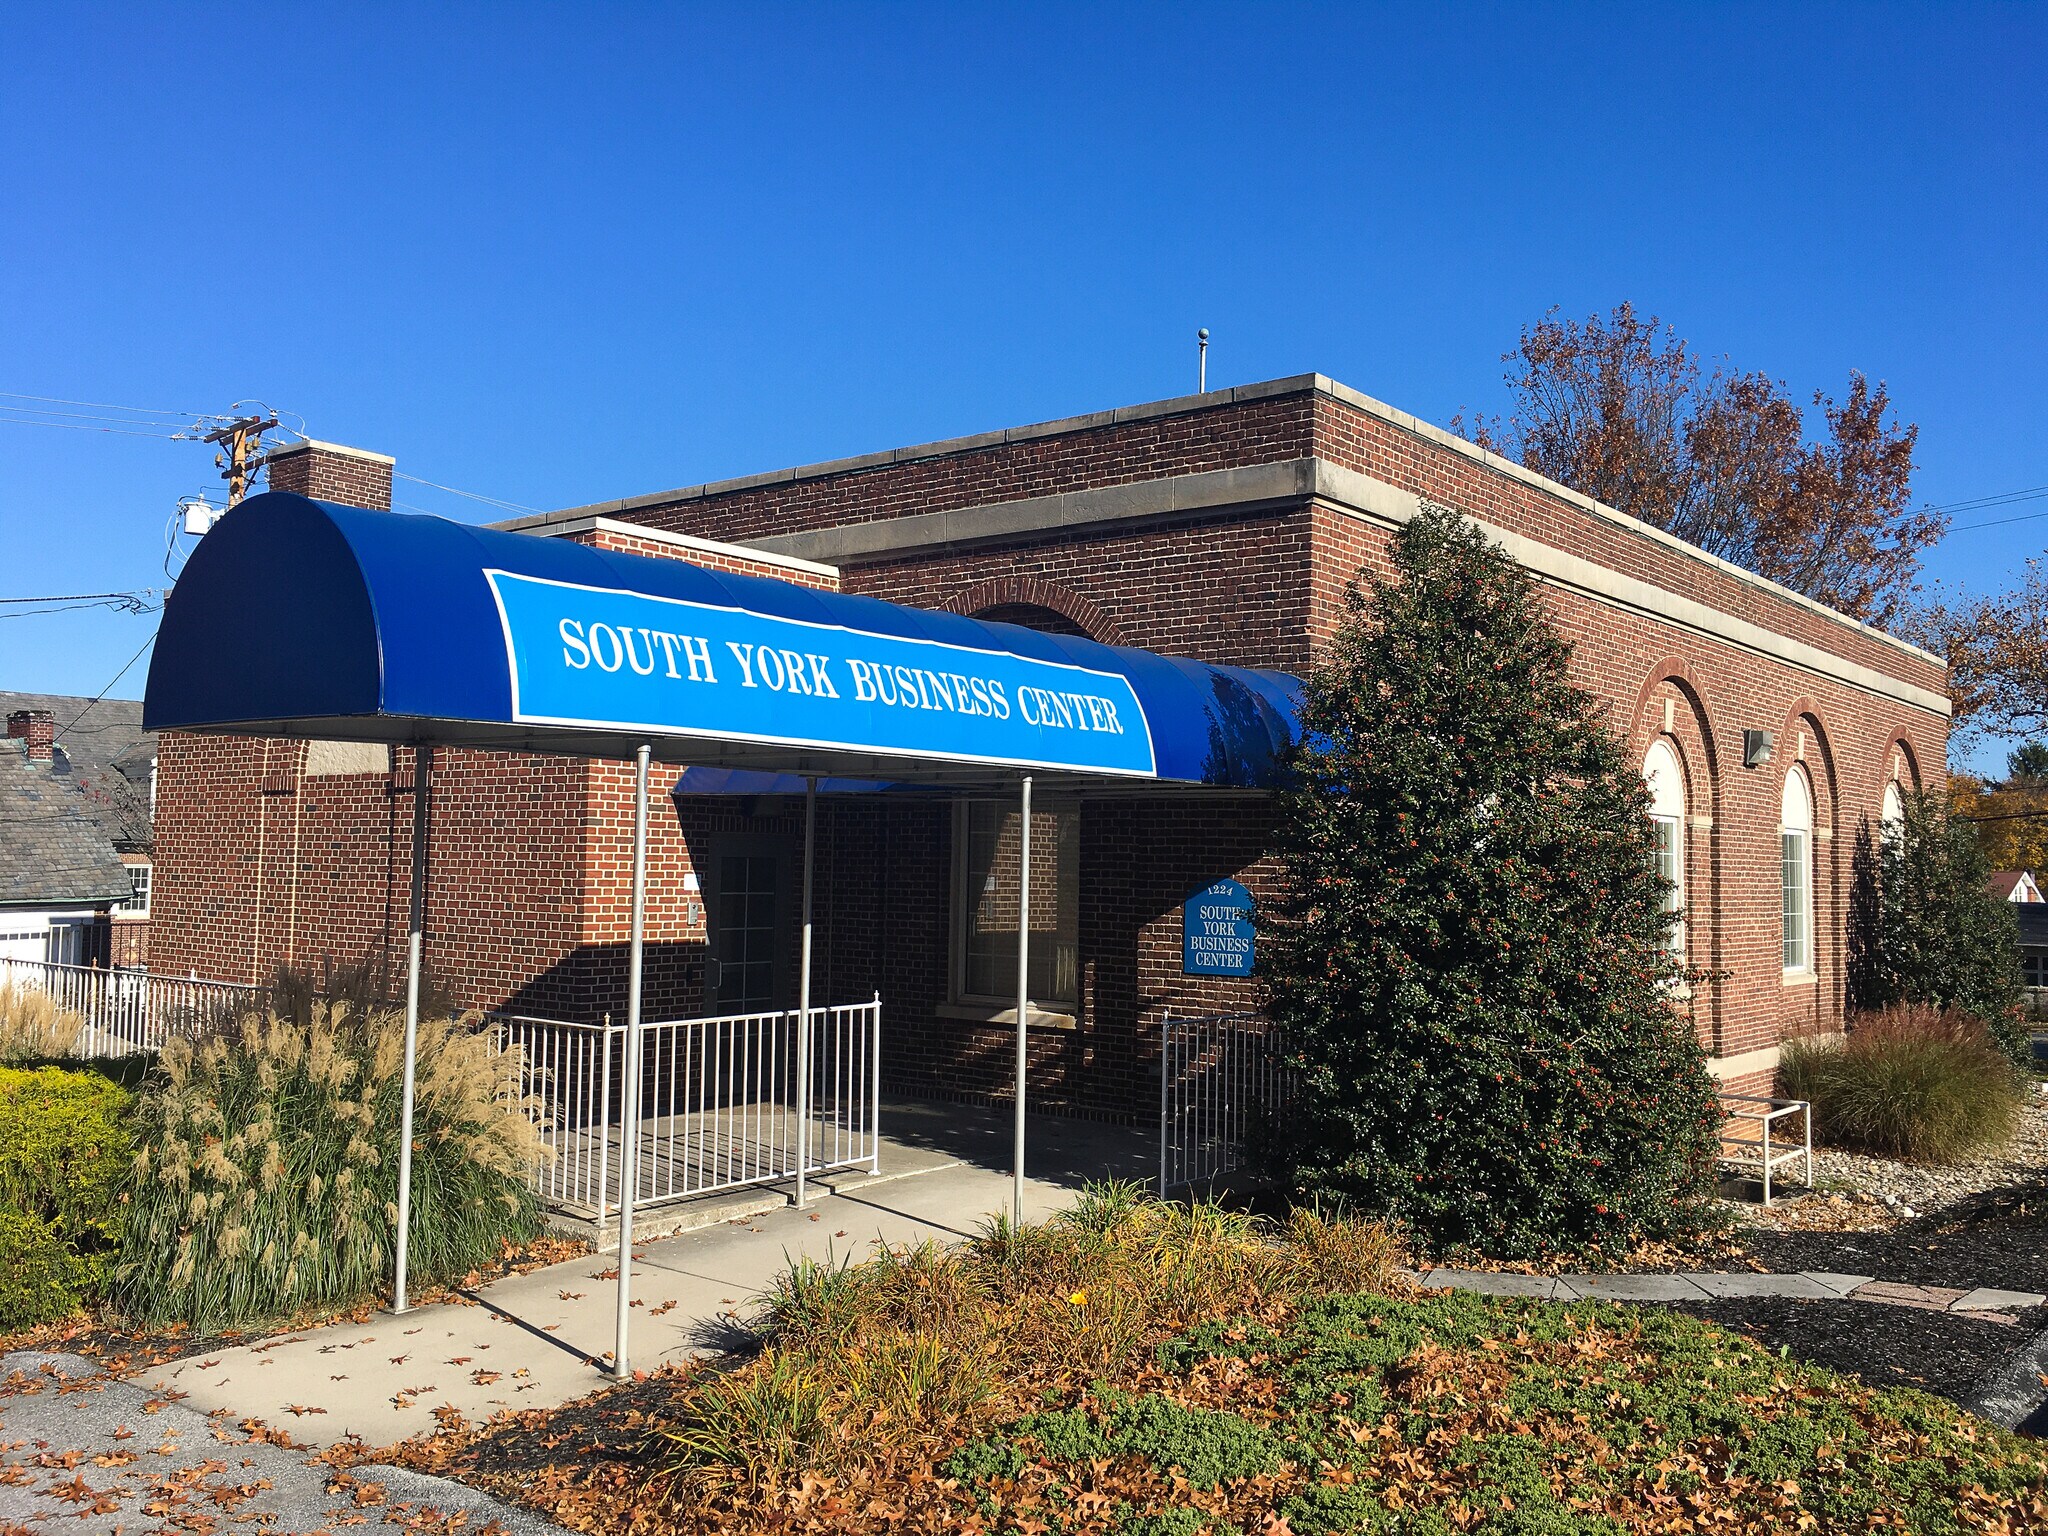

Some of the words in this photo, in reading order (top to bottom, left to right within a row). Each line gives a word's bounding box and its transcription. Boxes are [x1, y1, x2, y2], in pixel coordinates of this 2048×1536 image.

[558, 618, 718, 683] SOUTH
[726, 641, 840, 699] YORK
[845, 659, 1011, 720] BUSINESS
[1018, 686, 1125, 735] CENTER
[1207, 884, 1233, 896] 1224
[1200, 905, 1241, 921] SOUTH
[1203, 921, 1236, 936] YORK
[1190, 936, 1249, 952] BUSINESS
[1195, 951, 1243, 968] CENTER
